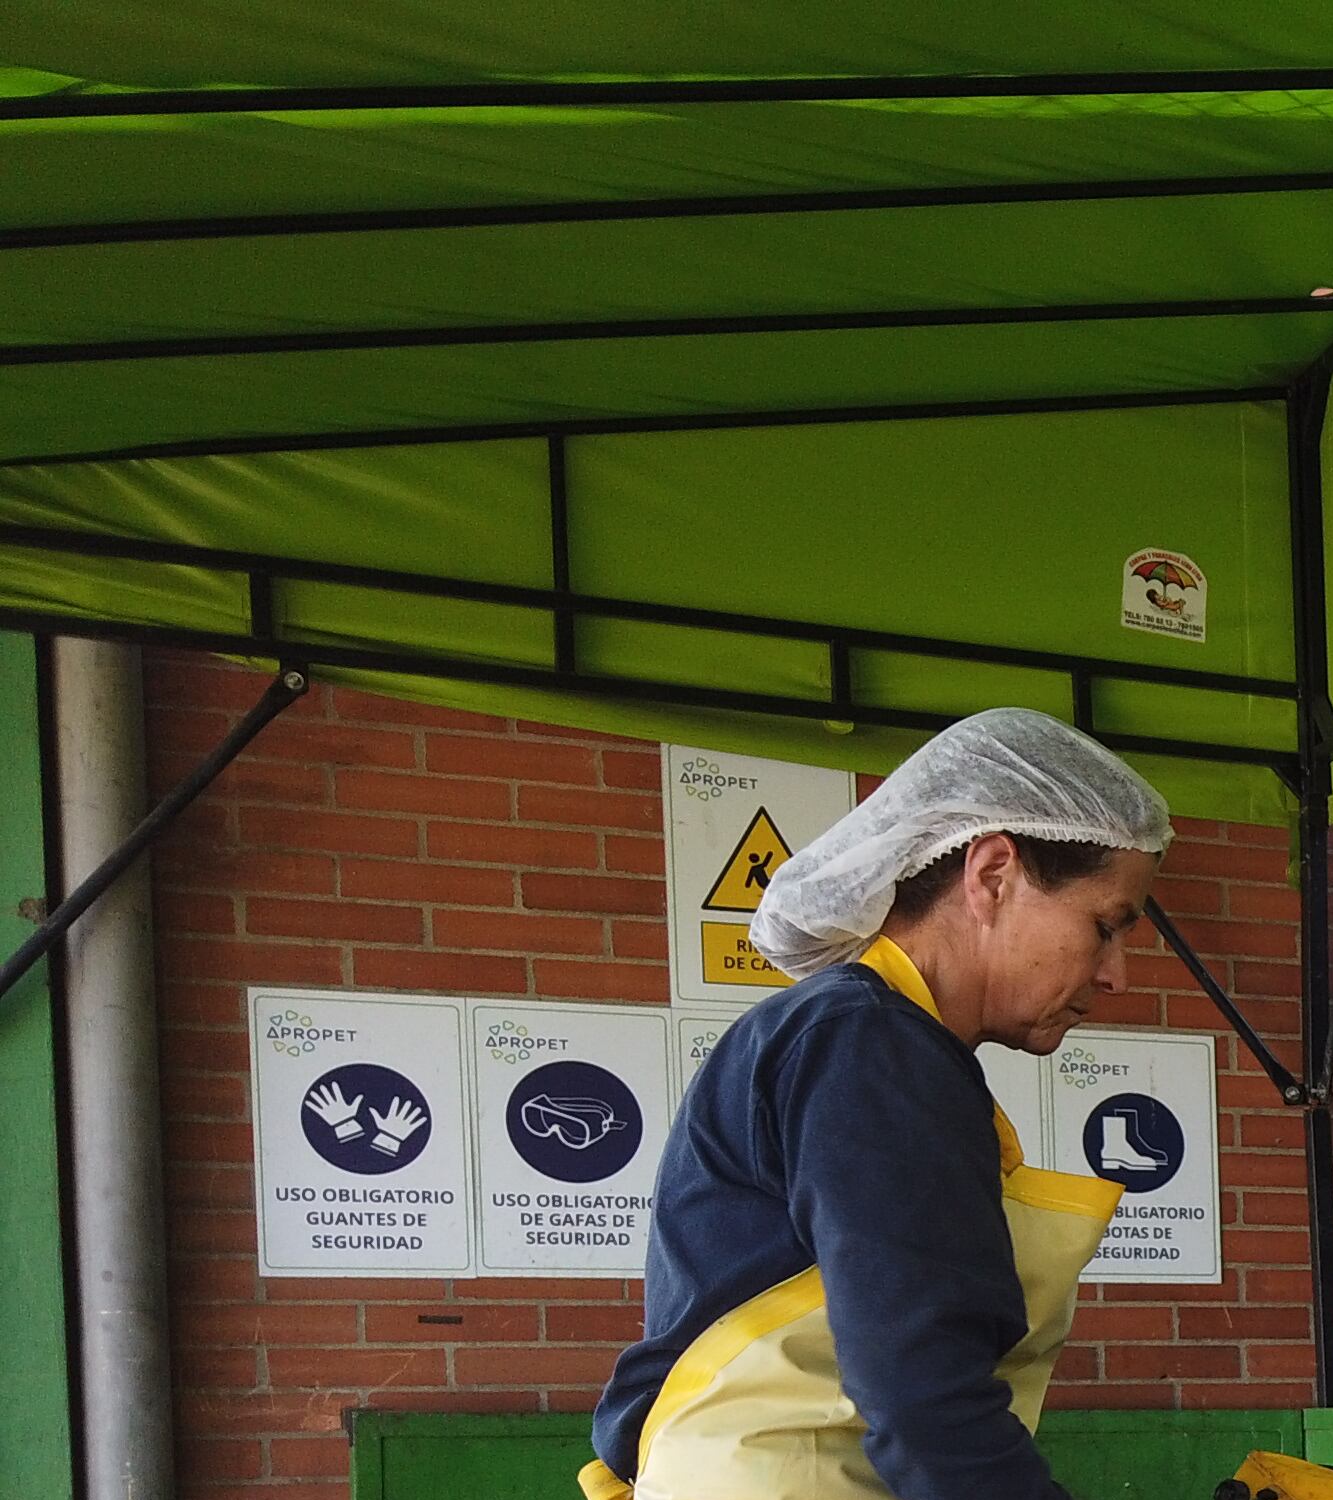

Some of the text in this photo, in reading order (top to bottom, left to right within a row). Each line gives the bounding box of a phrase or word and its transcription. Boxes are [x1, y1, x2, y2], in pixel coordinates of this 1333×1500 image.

[680, 772, 758, 790] APROPET
[724, 957, 745, 970] DE
[266, 1026, 357, 1042] APROPET
[485, 1036, 569, 1050] APROPET
[1059, 1063, 1130, 1076] APROPET
[275, 1187, 454, 1204] USO OBLIGATORIO
[492, 1193, 530, 1207] USO
[306, 1211, 427, 1227] GUANTES DE
[1115, 1206, 1205, 1219] BLIGATORIO
[520, 1212, 635, 1228] DE GAFAS DE
[526, 1231, 630, 1246] SEGURIDAD
[1153, 1228, 1172, 1239] DE
[311, 1235, 423, 1249] SEGURIDAD
[1094, 1247, 1180, 1259] SEGURIDAD
